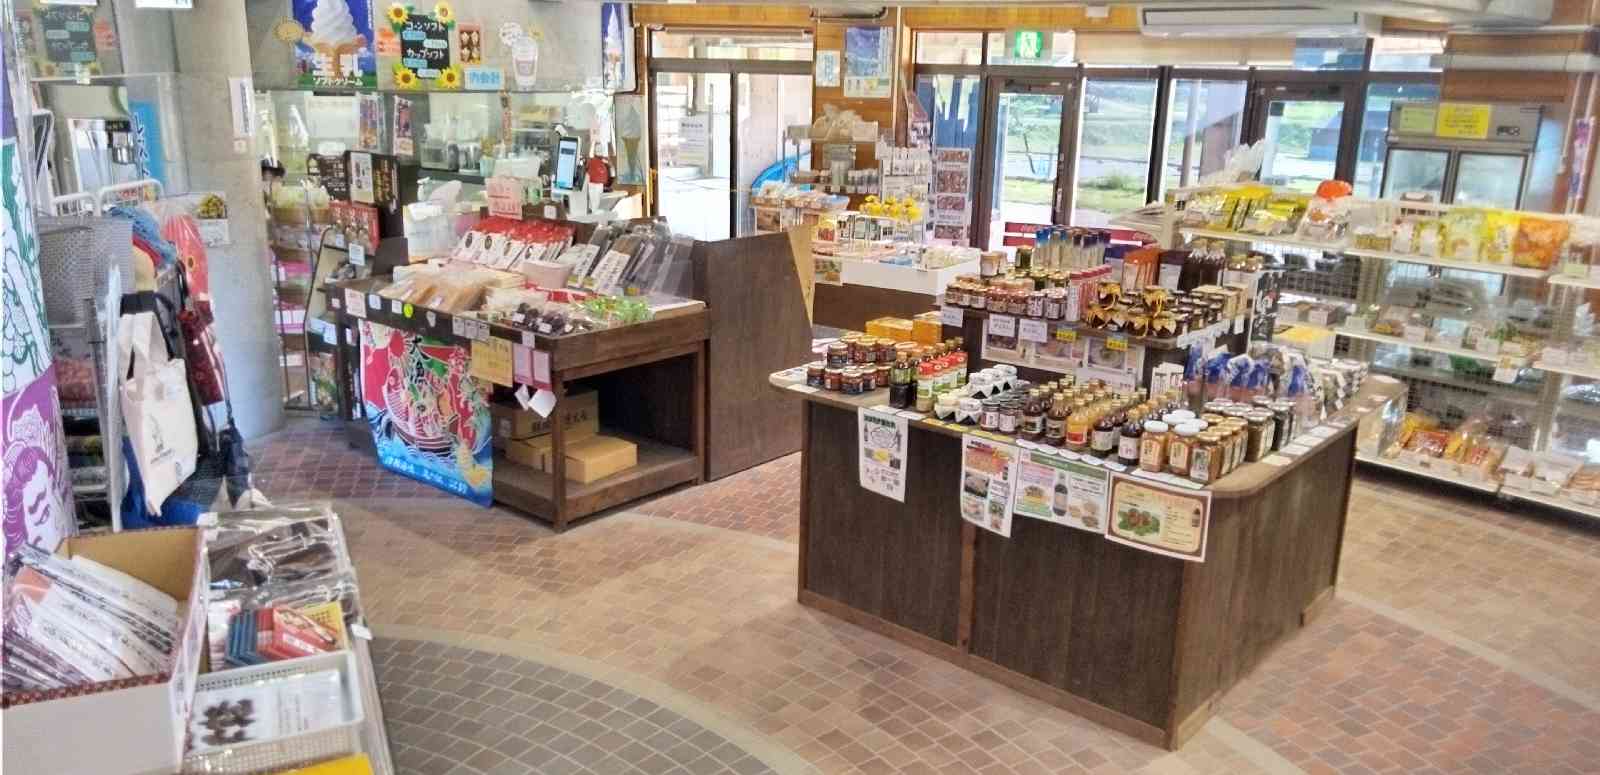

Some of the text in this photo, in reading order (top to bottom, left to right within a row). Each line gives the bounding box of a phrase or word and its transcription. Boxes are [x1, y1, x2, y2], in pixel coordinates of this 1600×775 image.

[406, 21, 446, 32] コーンソフト
[406, 48, 445, 60] カップソフト
